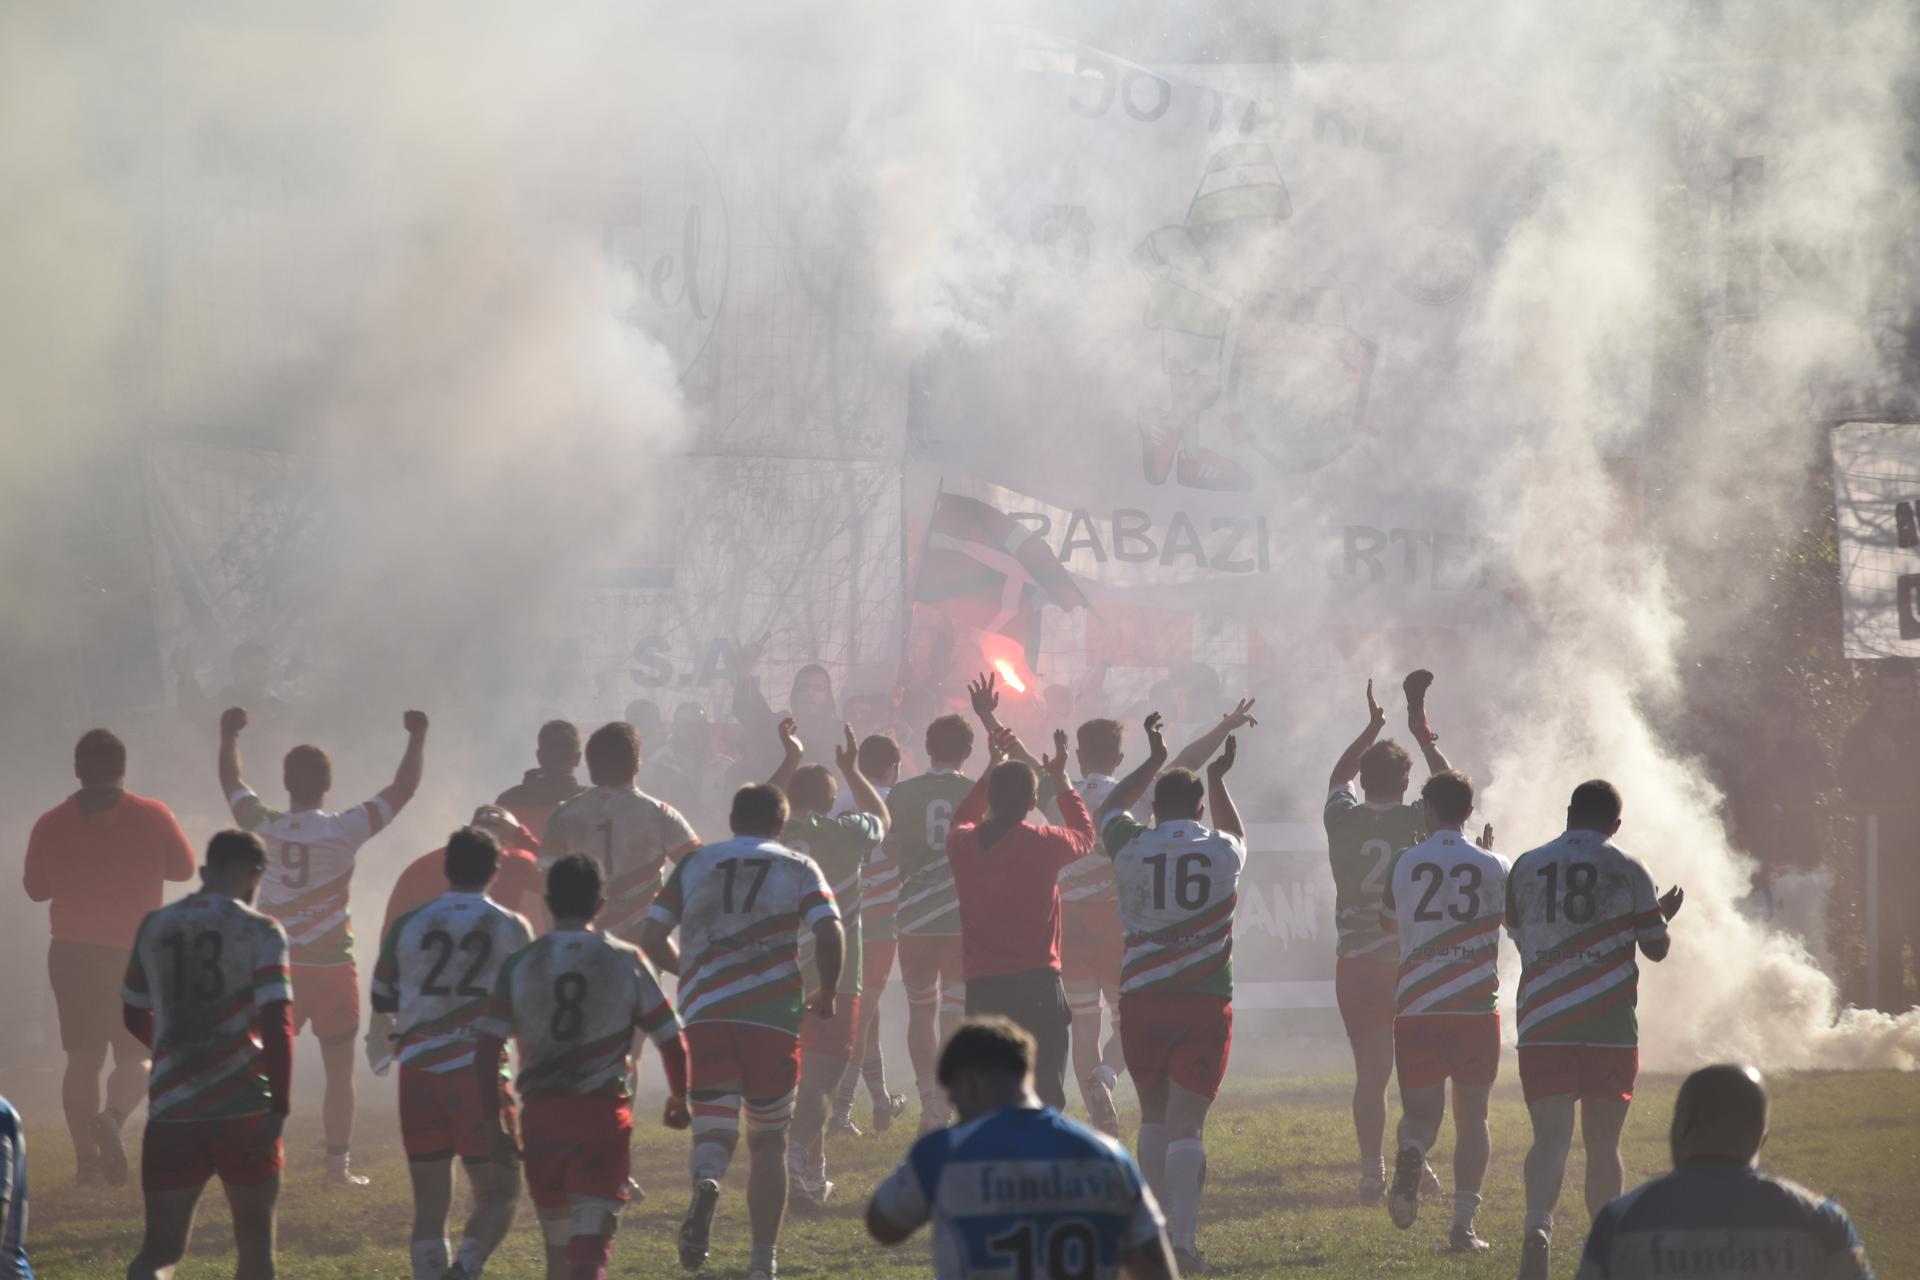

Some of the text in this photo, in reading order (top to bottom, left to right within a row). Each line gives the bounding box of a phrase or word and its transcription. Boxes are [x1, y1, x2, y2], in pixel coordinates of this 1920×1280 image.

[596, 818, 613, 875] 1
[926, 799, 954, 851] 6
[281, 841, 309, 889] 9
[716, 857, 773, 914] 17
[1142, 853, 1212, 911] 16
[1411, 862, 1483, 922] 23
[1536, 861, 1598, 924] 18
[162, 929, 224, 1002] 13
[420, 930, 494, 996] 22
[553, 971, 588, 1042] 8
[1651, 1230, 1797, 1276] fundavi
